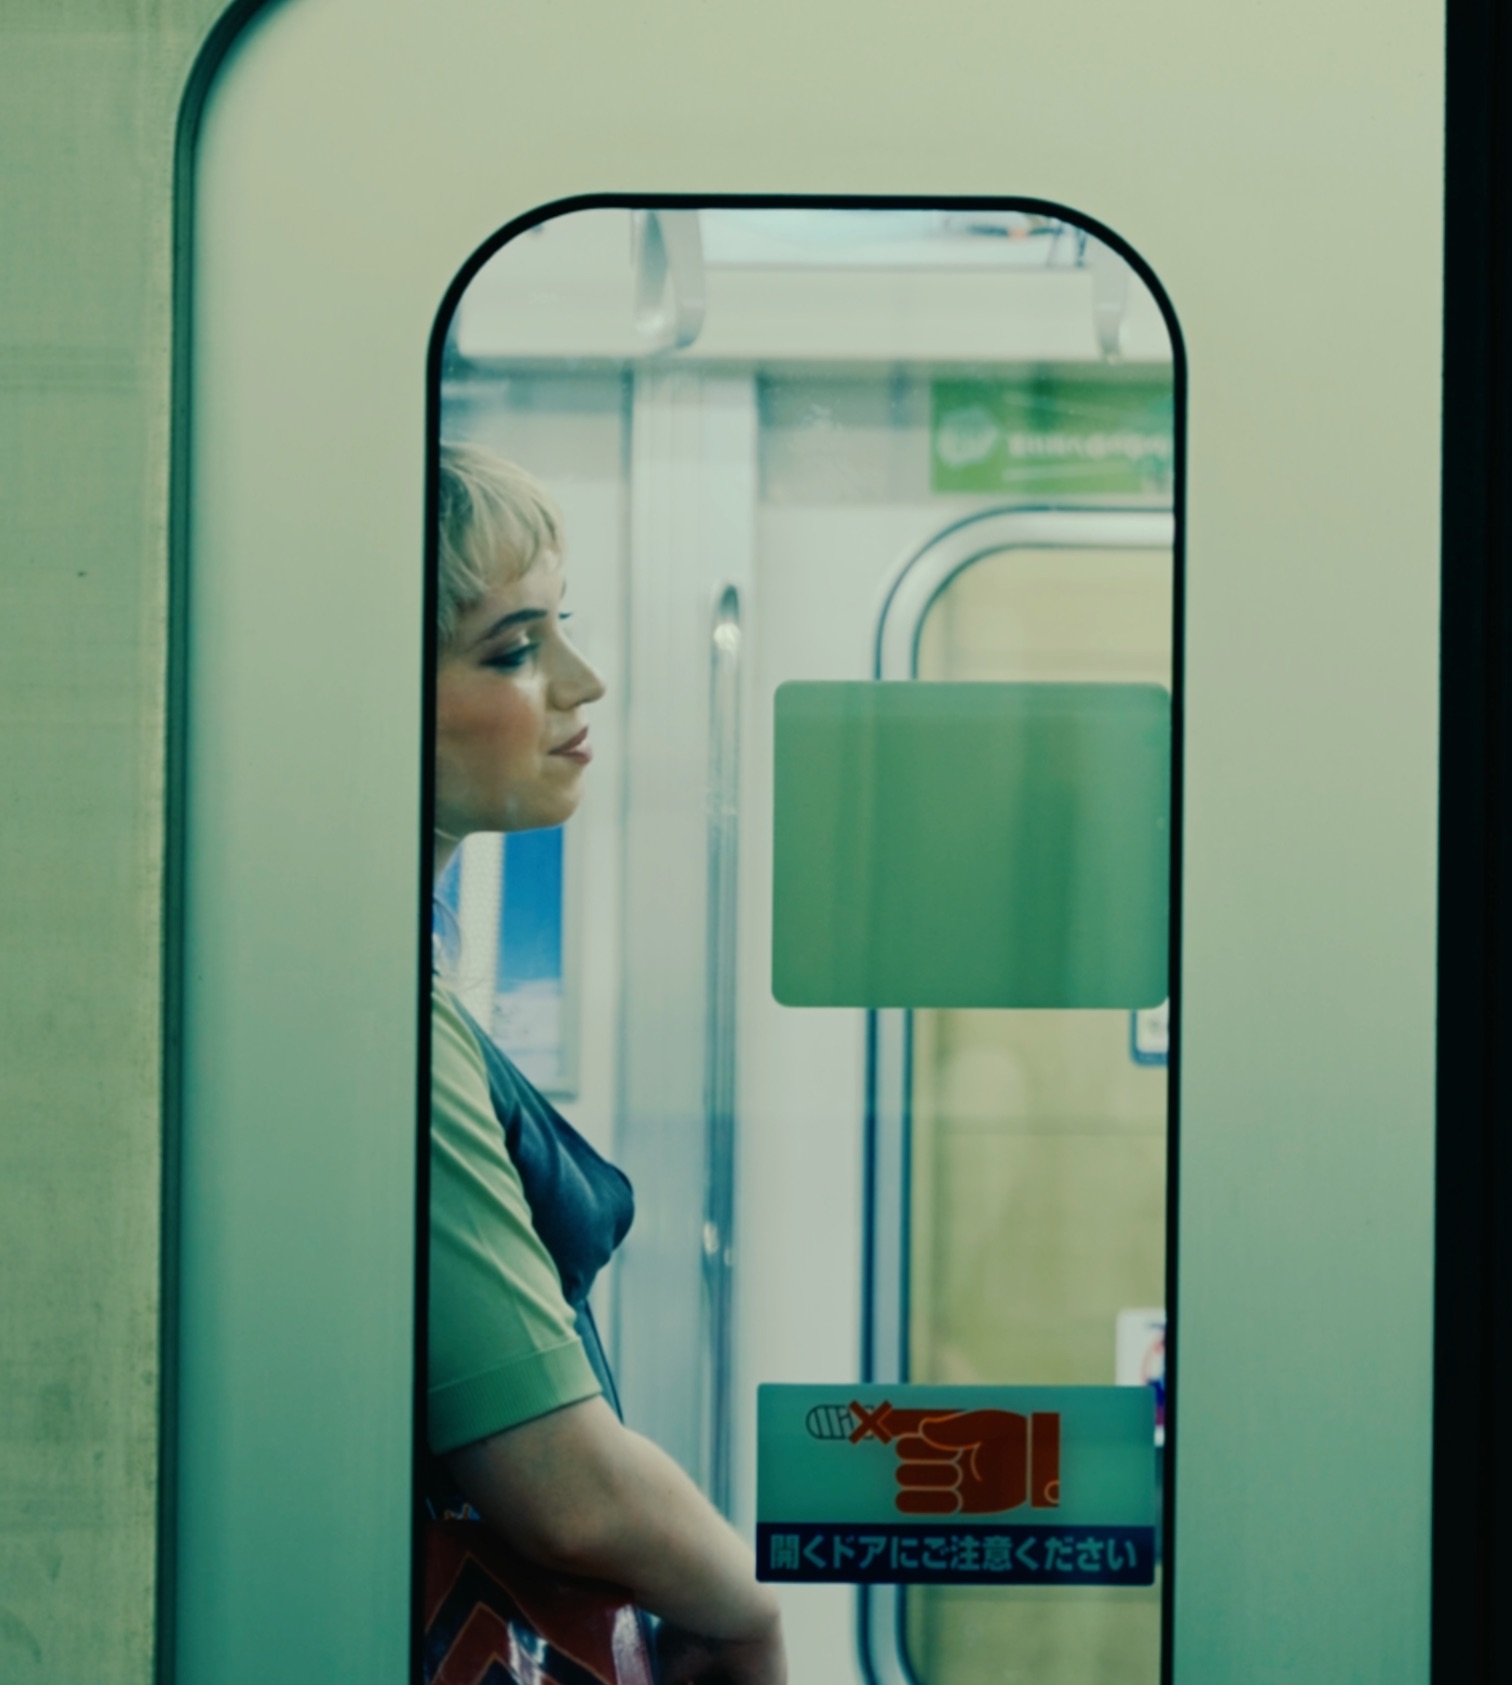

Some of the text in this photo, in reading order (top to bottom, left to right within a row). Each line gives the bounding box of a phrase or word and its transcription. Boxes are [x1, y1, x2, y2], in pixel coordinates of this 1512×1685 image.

[769, 1534, 1137, 1571] 開くドアにご注意ください
